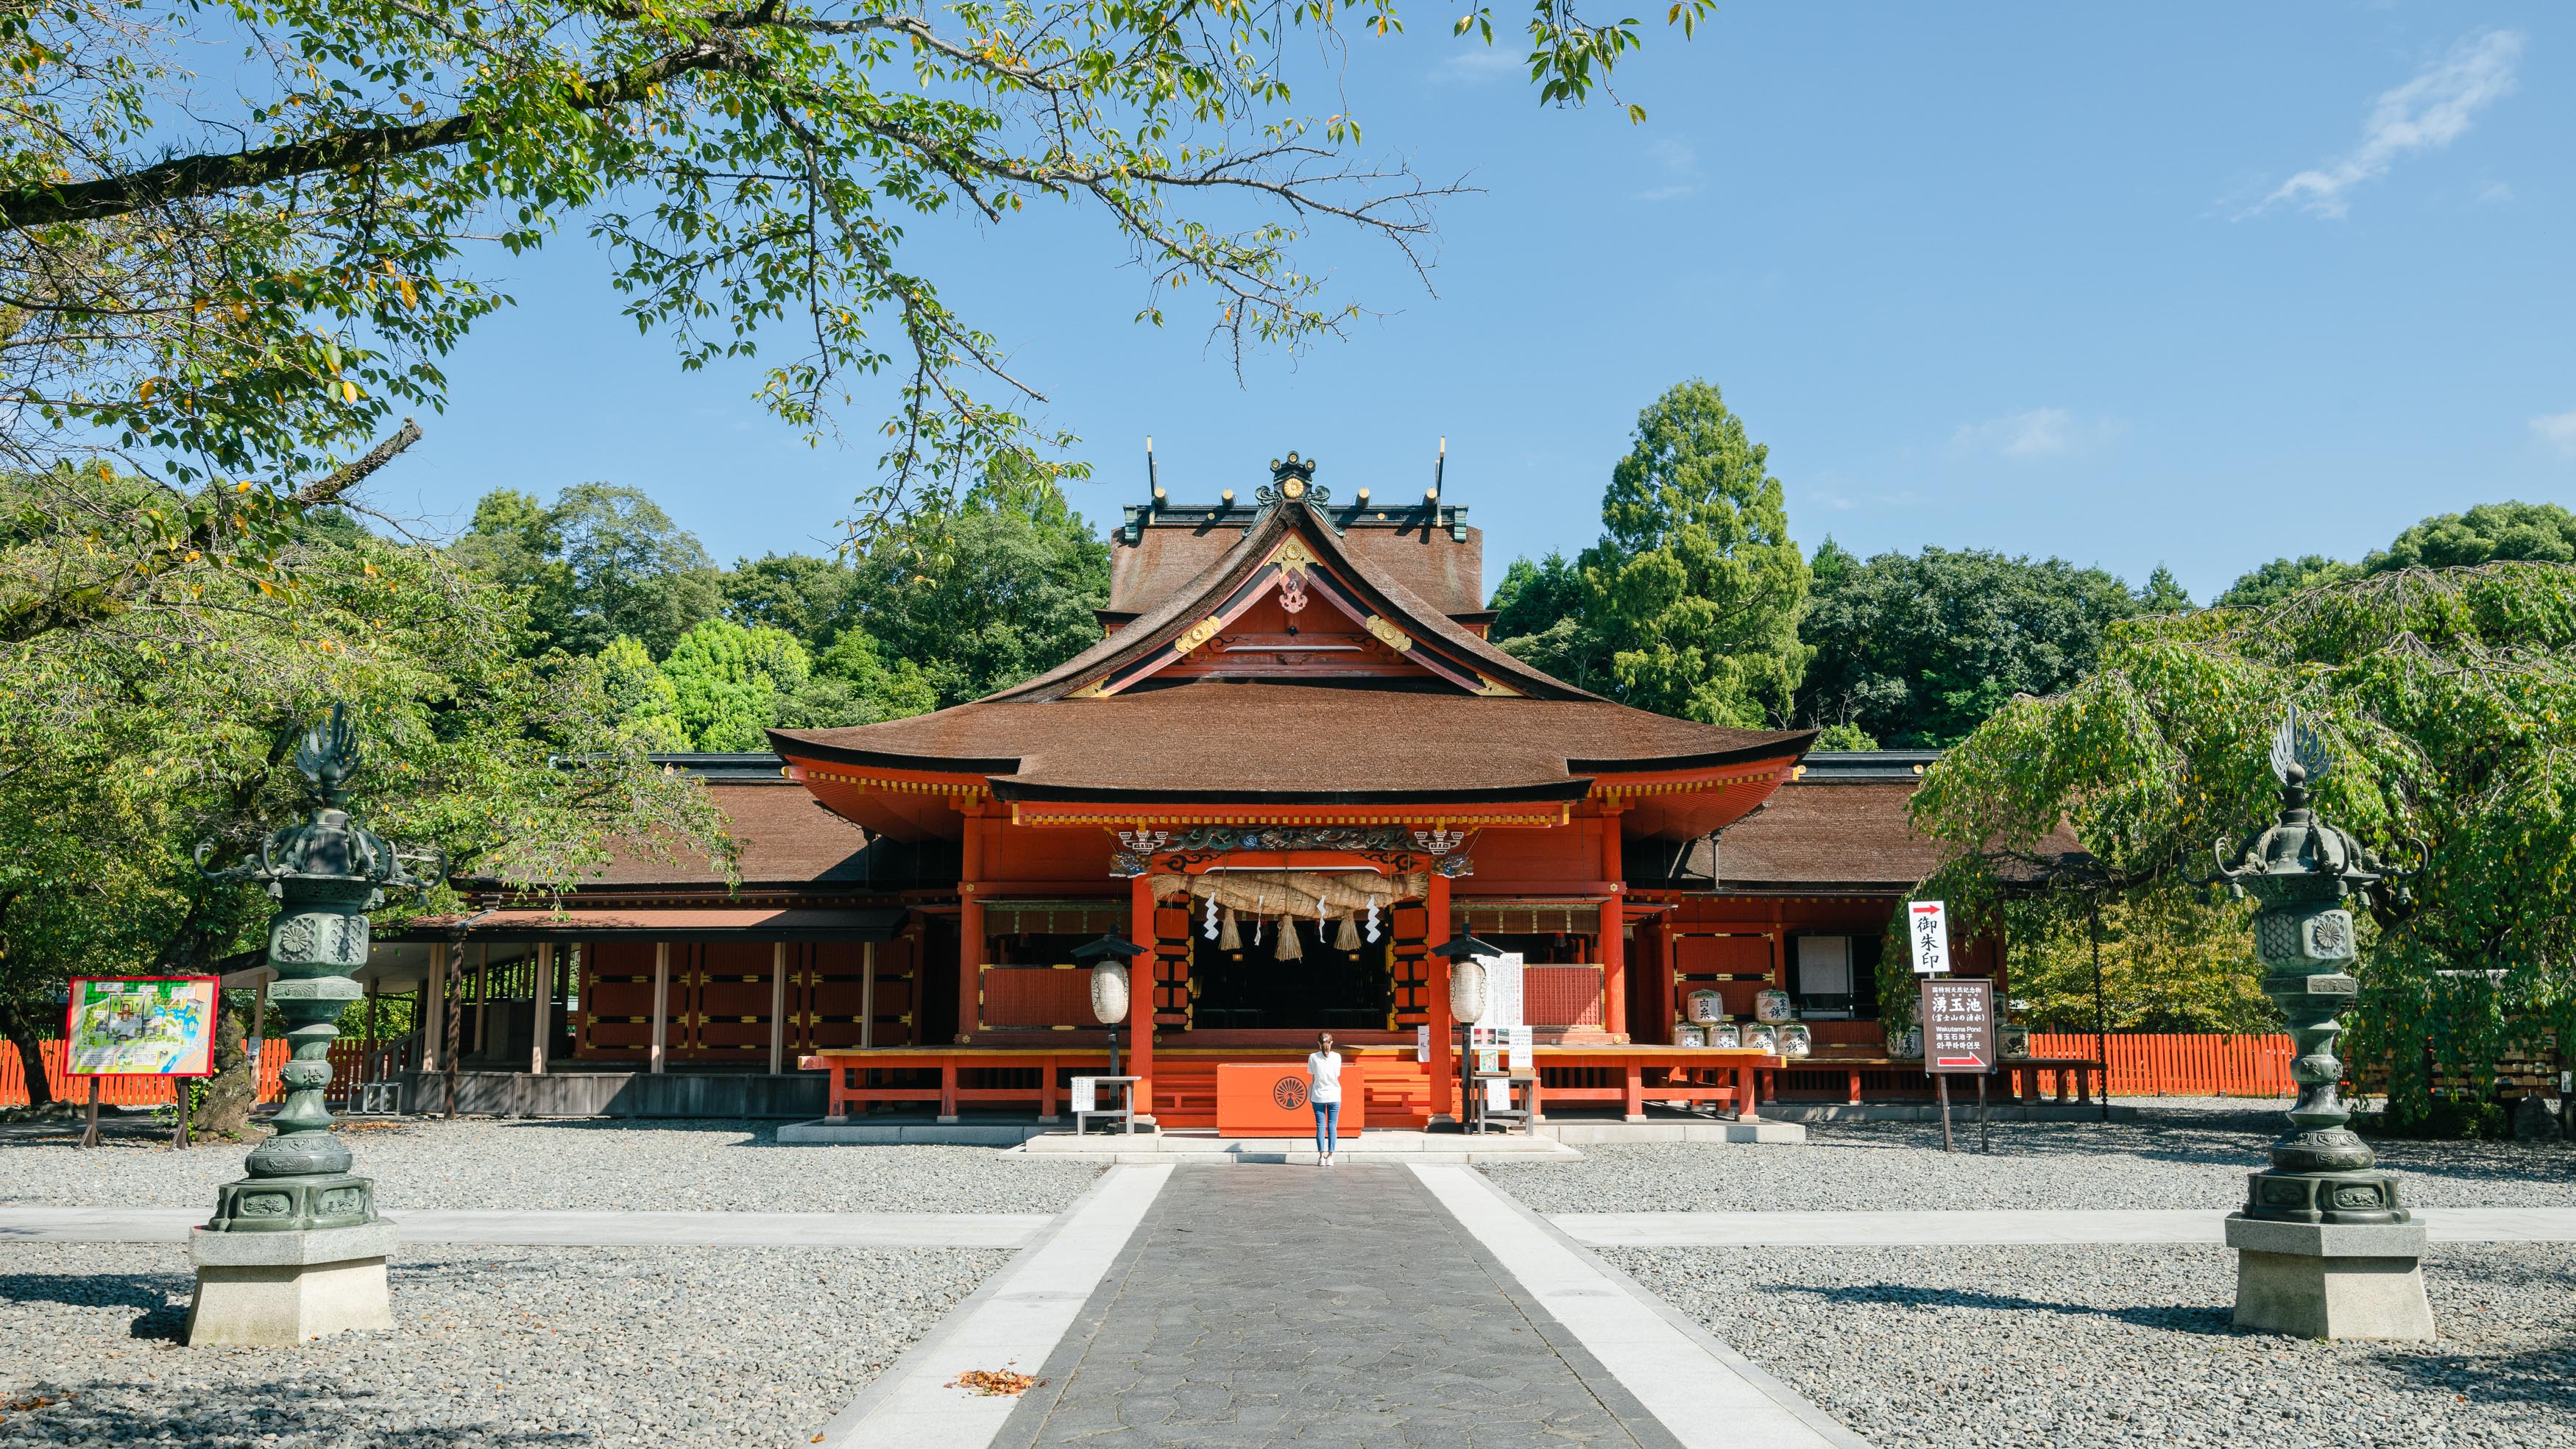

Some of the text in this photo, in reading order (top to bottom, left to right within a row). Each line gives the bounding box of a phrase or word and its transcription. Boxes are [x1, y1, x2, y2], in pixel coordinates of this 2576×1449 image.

[1917, 915, 1939, 969] 御朱印
[1699, 999, 1710, 1020] 白糸
[1932, 996, 1983, 1013] 湧玉池
[1931, 1013, 1985, 1022] (富士山の湧水)
